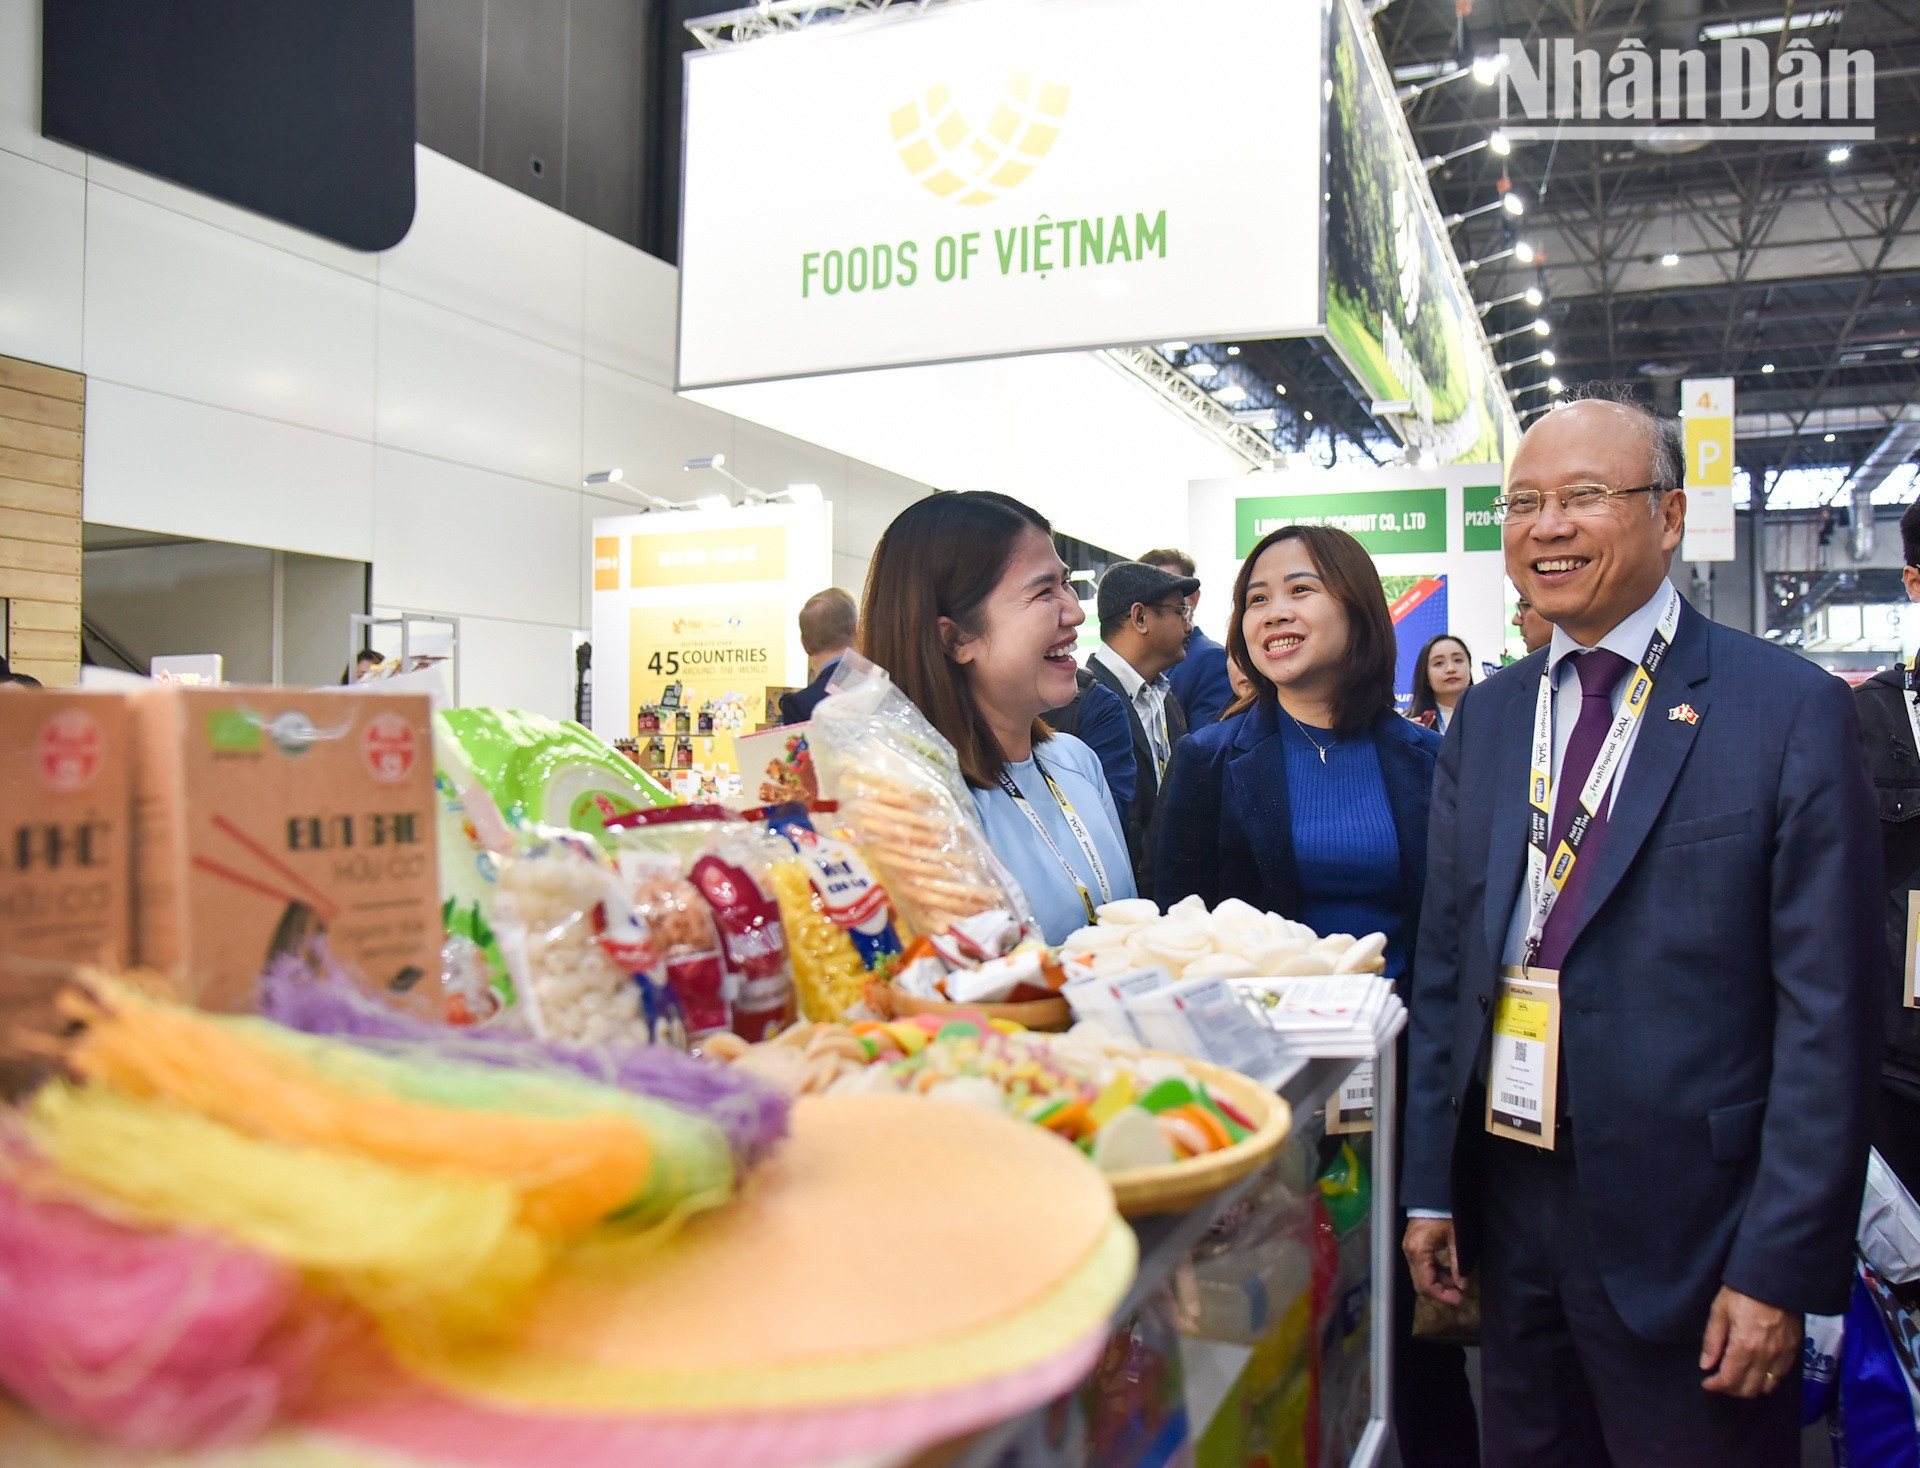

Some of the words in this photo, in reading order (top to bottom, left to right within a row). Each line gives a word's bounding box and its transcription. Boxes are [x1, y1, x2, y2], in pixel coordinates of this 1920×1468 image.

[801, 240, 918, 299] FOODS
[935, 232, 981, 283] OF
[994, 209, 1168, 280] VIỆTNAM
[1698, 440, 1721, 479] P
[1403, 512, 1426, 531] LTD
[647, 651, 679, 675] 45
[681, 648, 767, 665] COUNTRIES
[682, 666, 716, 676] AROUND
[720, 665, 733, 675] THE
[738, 664, 768, 675] WORLD
[1538, 743, 1546, 765] SIAL
[1588, 741, 1617, 792] FreshTropical
[1612, 713, 1631, 740] SIAL
[1070, 815, 1084, 838] SIAL
[1082, 840, 1106, 888] FreshTropical
[1511, 1117, 1523, 1127] VIP
